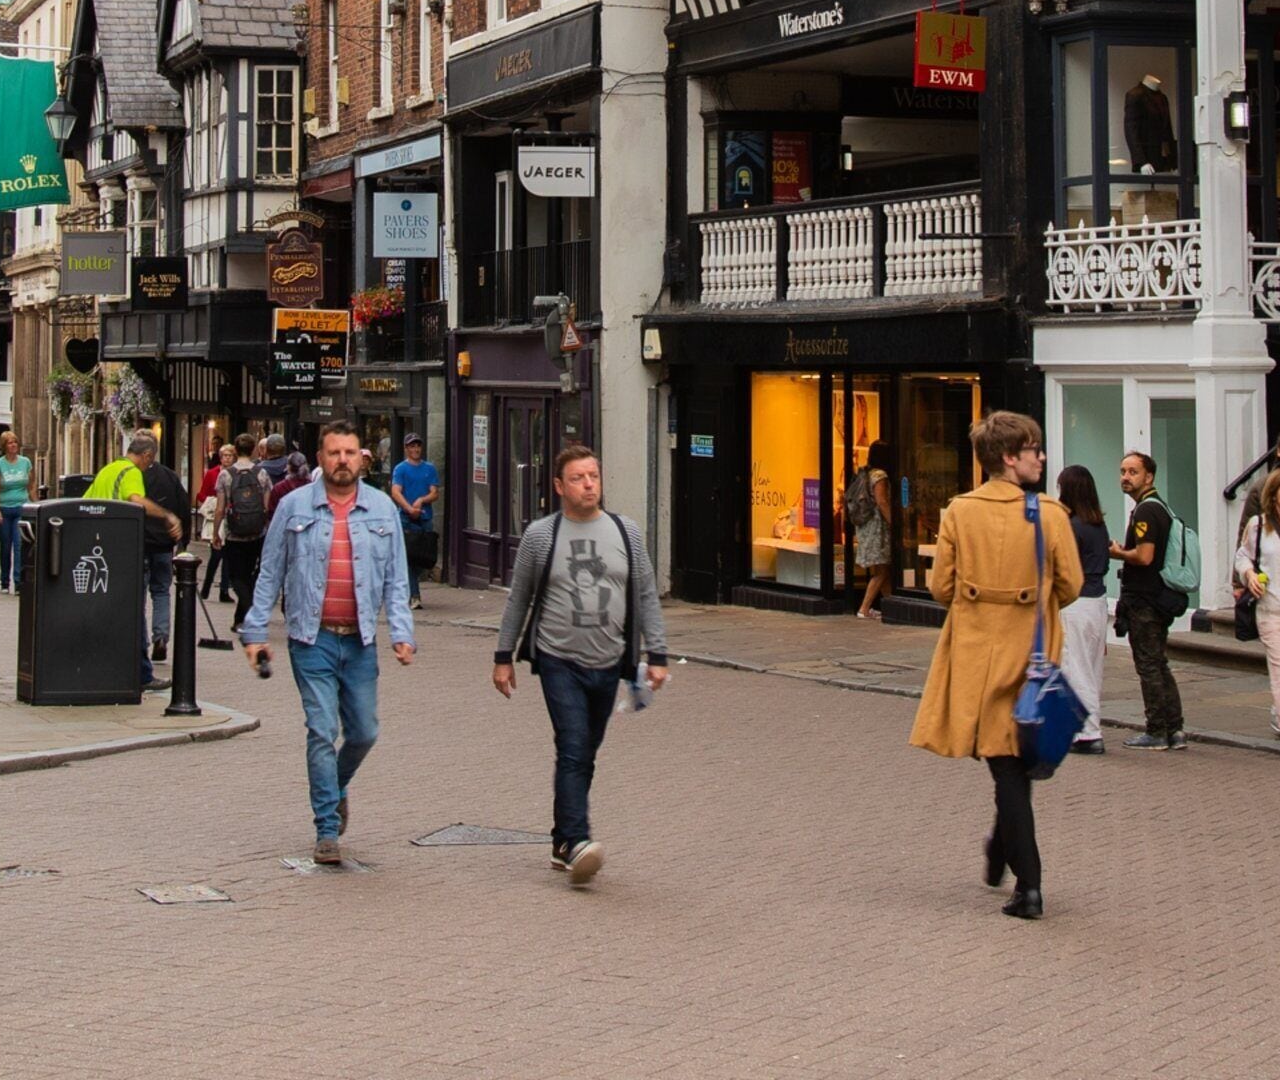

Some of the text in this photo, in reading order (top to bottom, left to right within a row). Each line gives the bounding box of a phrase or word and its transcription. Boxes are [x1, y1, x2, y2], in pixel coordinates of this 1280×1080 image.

[777, 1, 844, 39] Waterstone's
[495, 48, 533, 82] JAEGER
[928, 68, 975, 88] EWM
[523, 165, 586, 179] JAEGER
[0, 173, 63, 194] ROLEX
[383, 214, 430, 227] PAVERS
[385, 227, 428, 240] SHOES
[138, 273, 181, 286] Jack Wills
[294, 320, 331, 330] TO LET
[785, 326, 849, 364] Accessorize
[273, 351, 293, 360] The
[280, 361, 316, 370] WATCH
[295, 373, 315, 383] Lab
